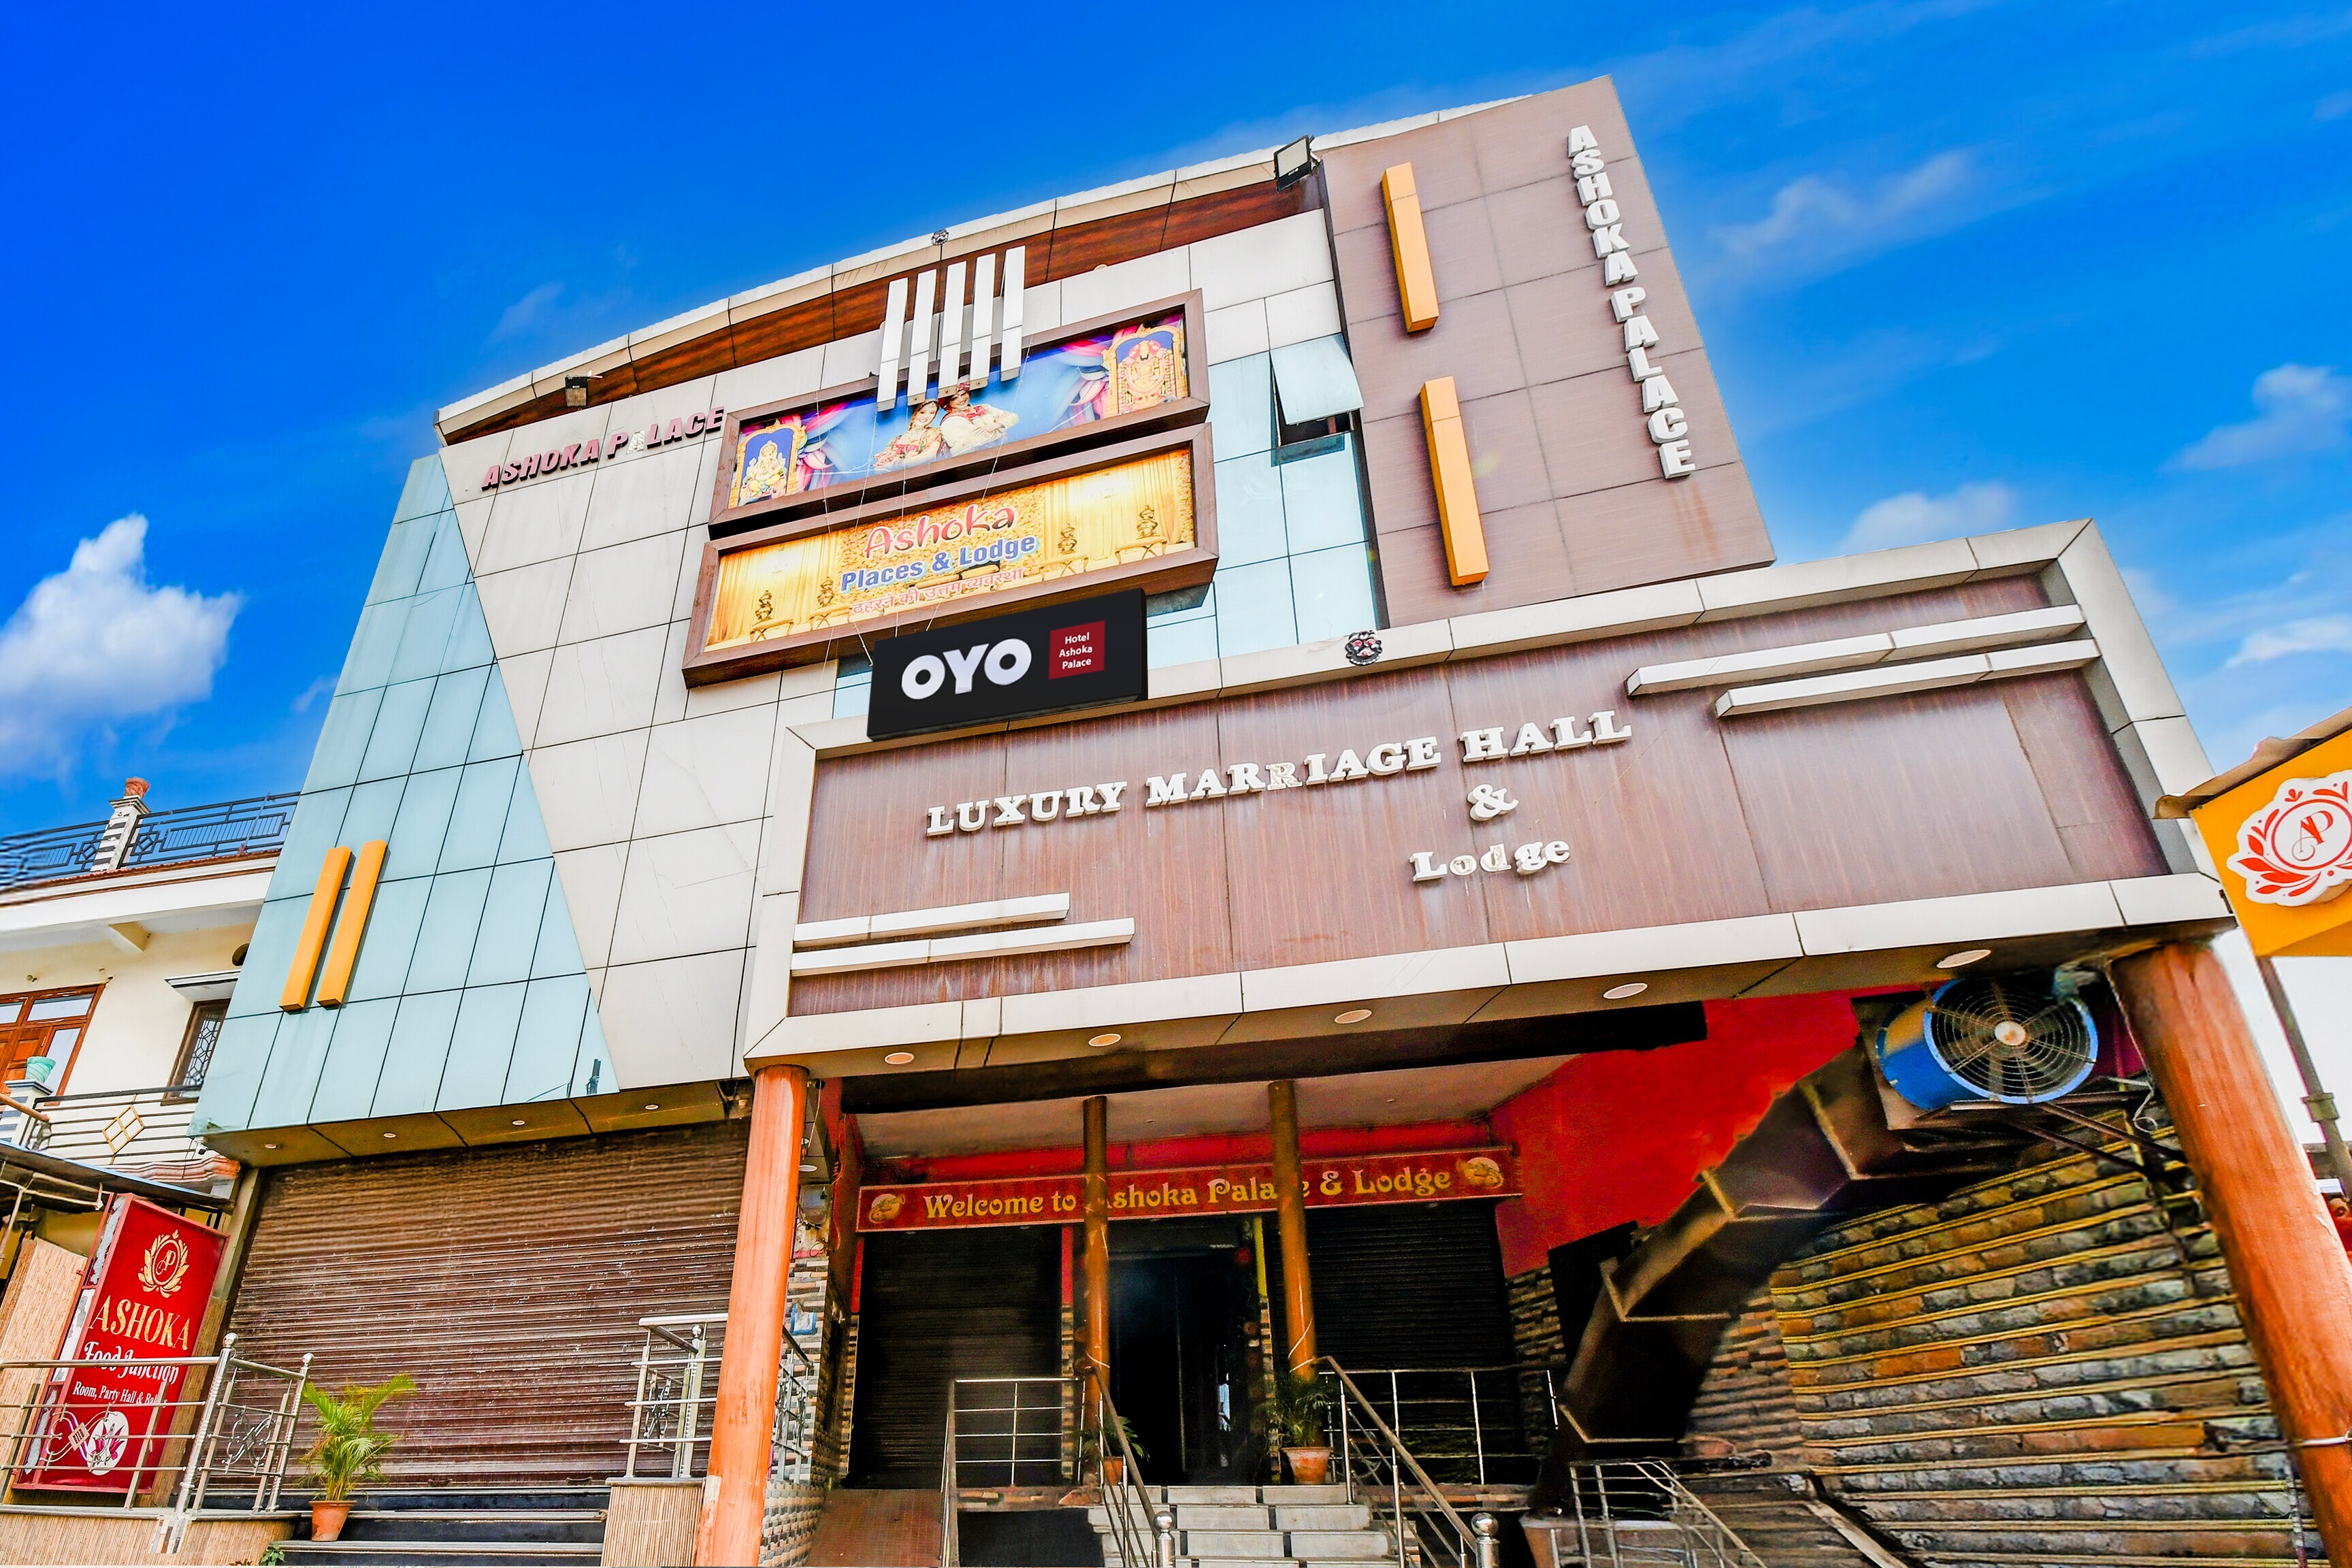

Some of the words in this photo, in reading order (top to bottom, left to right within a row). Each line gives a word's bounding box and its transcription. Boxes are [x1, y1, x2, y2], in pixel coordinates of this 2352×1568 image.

[1567, 125, 1638, 287] ASHOKA
[1610, 287, 1696, 479] PALACE
[480, 438, 600, 491] ASHOKA
[607, 406, 724, 459] PALACE
[864, 504, 1016, 559] Ashoka
[841, 561, 924, 591] Places
[932, 552, 949, 572] &
[960, 536, 1036, 566] Lodge
[851, 594, 896, 614] ठहरने
[899, 588, 919, 604] की
[924, 581, 963, 598] उत्तम
[966, 568, 1024, 588] व्यवस्था
[1059, 644, 1092, 658] Ashoka
[1062, 658, 1092, 670] Palace
[1064, 632, 1090, 644] Hotel
[902, 638, 1032, 700] OYO
[926, 781, 1127, 836] LUXURY
[1145, 736, 1441, 807] MARRIAGE
[1460, 709, 1632, 762] HALL
[1467, 783, 1519, 821] &
[1409, 839, 1571, 883] Lodge
[923, 1192, 1043, 1219] Welcome
[1051, 1192, 1076, 1212] to
[1106, 1181, 1198, 1209] shoka
[1207, 1176, 1310, 1205] Palae
[1320, 1170, 1343, 1196] &
[1352, 1166, 1451, 1197] Lodge
[88, 1294, 191, 1351] ASHOKA
[72, 1381, 97, 1401] Room,
[98, 1385, 120, 1404] Party
[120, 1388, 137, 1403] Hall
[135, 1391, 144, 1405] &
